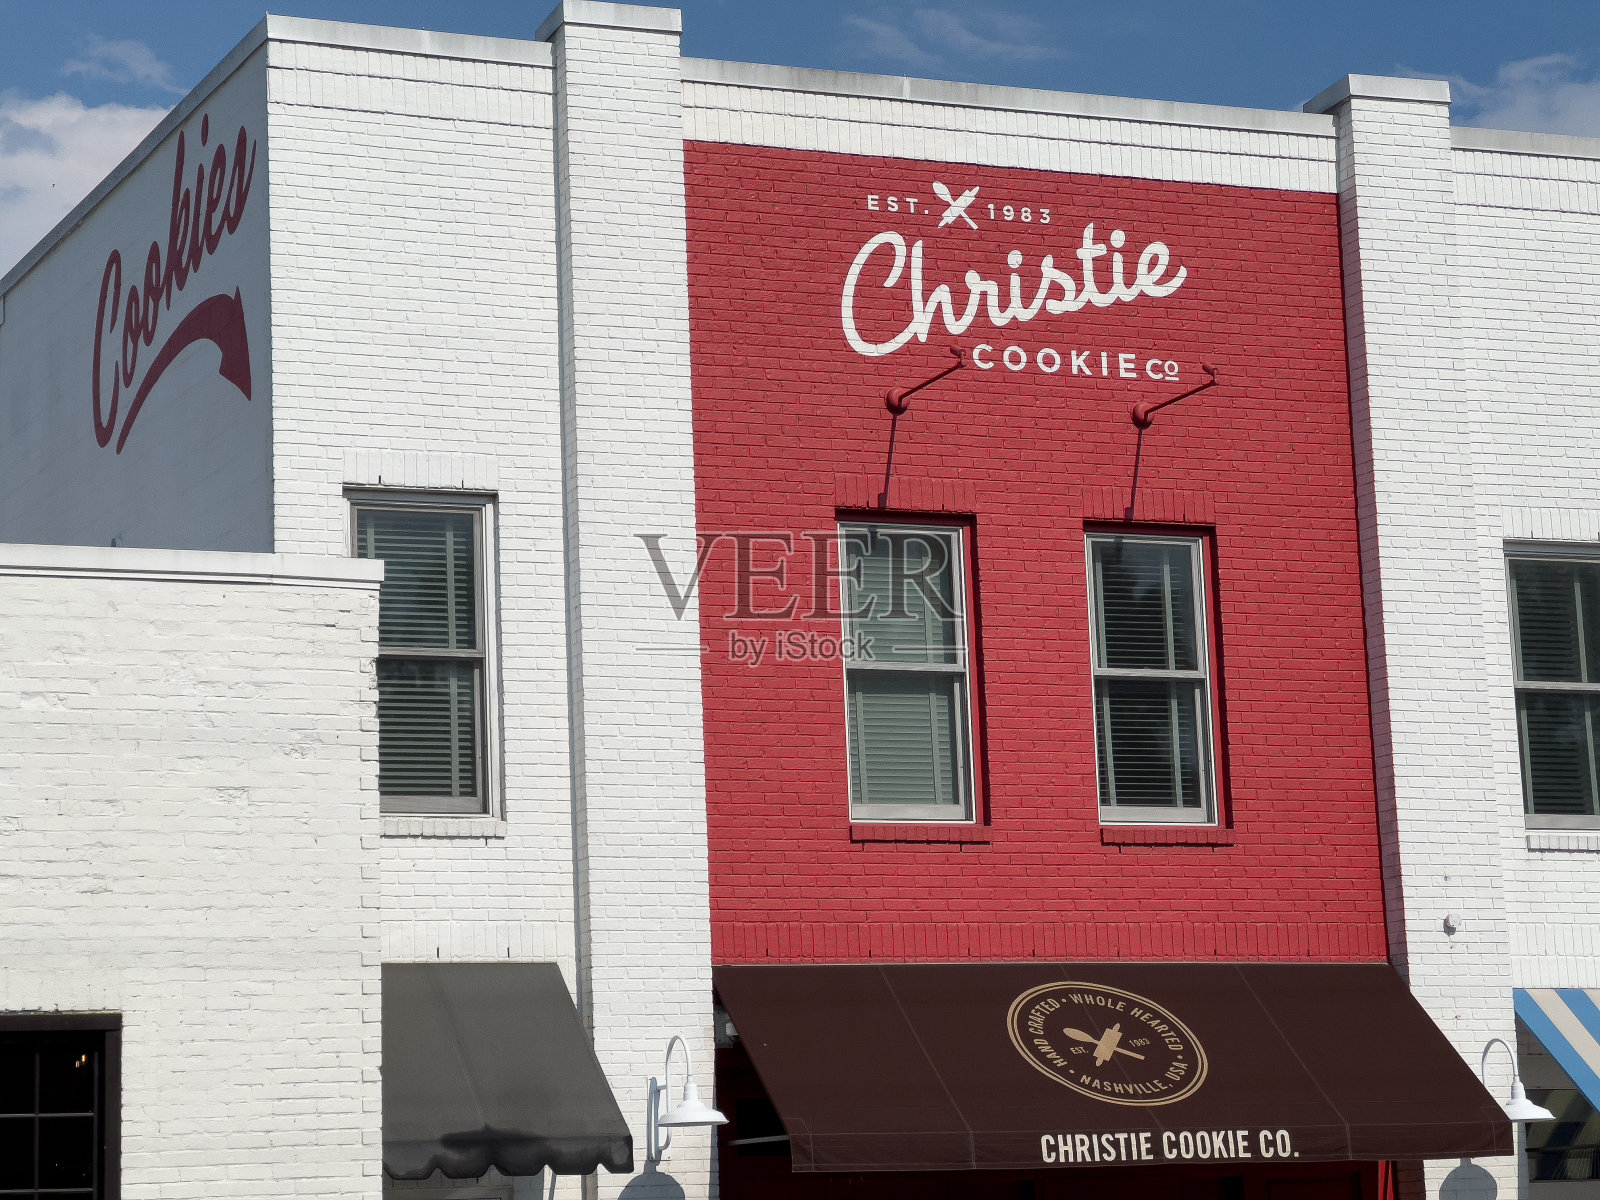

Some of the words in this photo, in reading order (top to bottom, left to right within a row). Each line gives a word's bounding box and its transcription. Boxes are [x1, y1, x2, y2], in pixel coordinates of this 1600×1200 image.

[867, 194, 930, 215] EST.
[987, 203, 1051, 224] 1983
[92, 113, 257, 448] Cookies
[841, 222, 1188, 357] Christie
[972, 343, 1138, 379] COOKIE
[1027, 998, 1061, 1035] CRAFTED
[1068, 993, 1126, 1011] WHOLE
[1130, 1007, 1184, 1051] HEARTED
[1033, 1038, 1068, 1067] HAND
[1069, 1045, 1089, 1055] EST.
[1079, 1074, 1174, 1095] NASHVILLE,
[1164, 1061, 1188, 1081] USA
[1040, 1132, 1154, 1163] CHRISTIE
[1162, 1129, 1252, 1159] COOKIE
[1258, 1129, 1300, 1158] CO.
